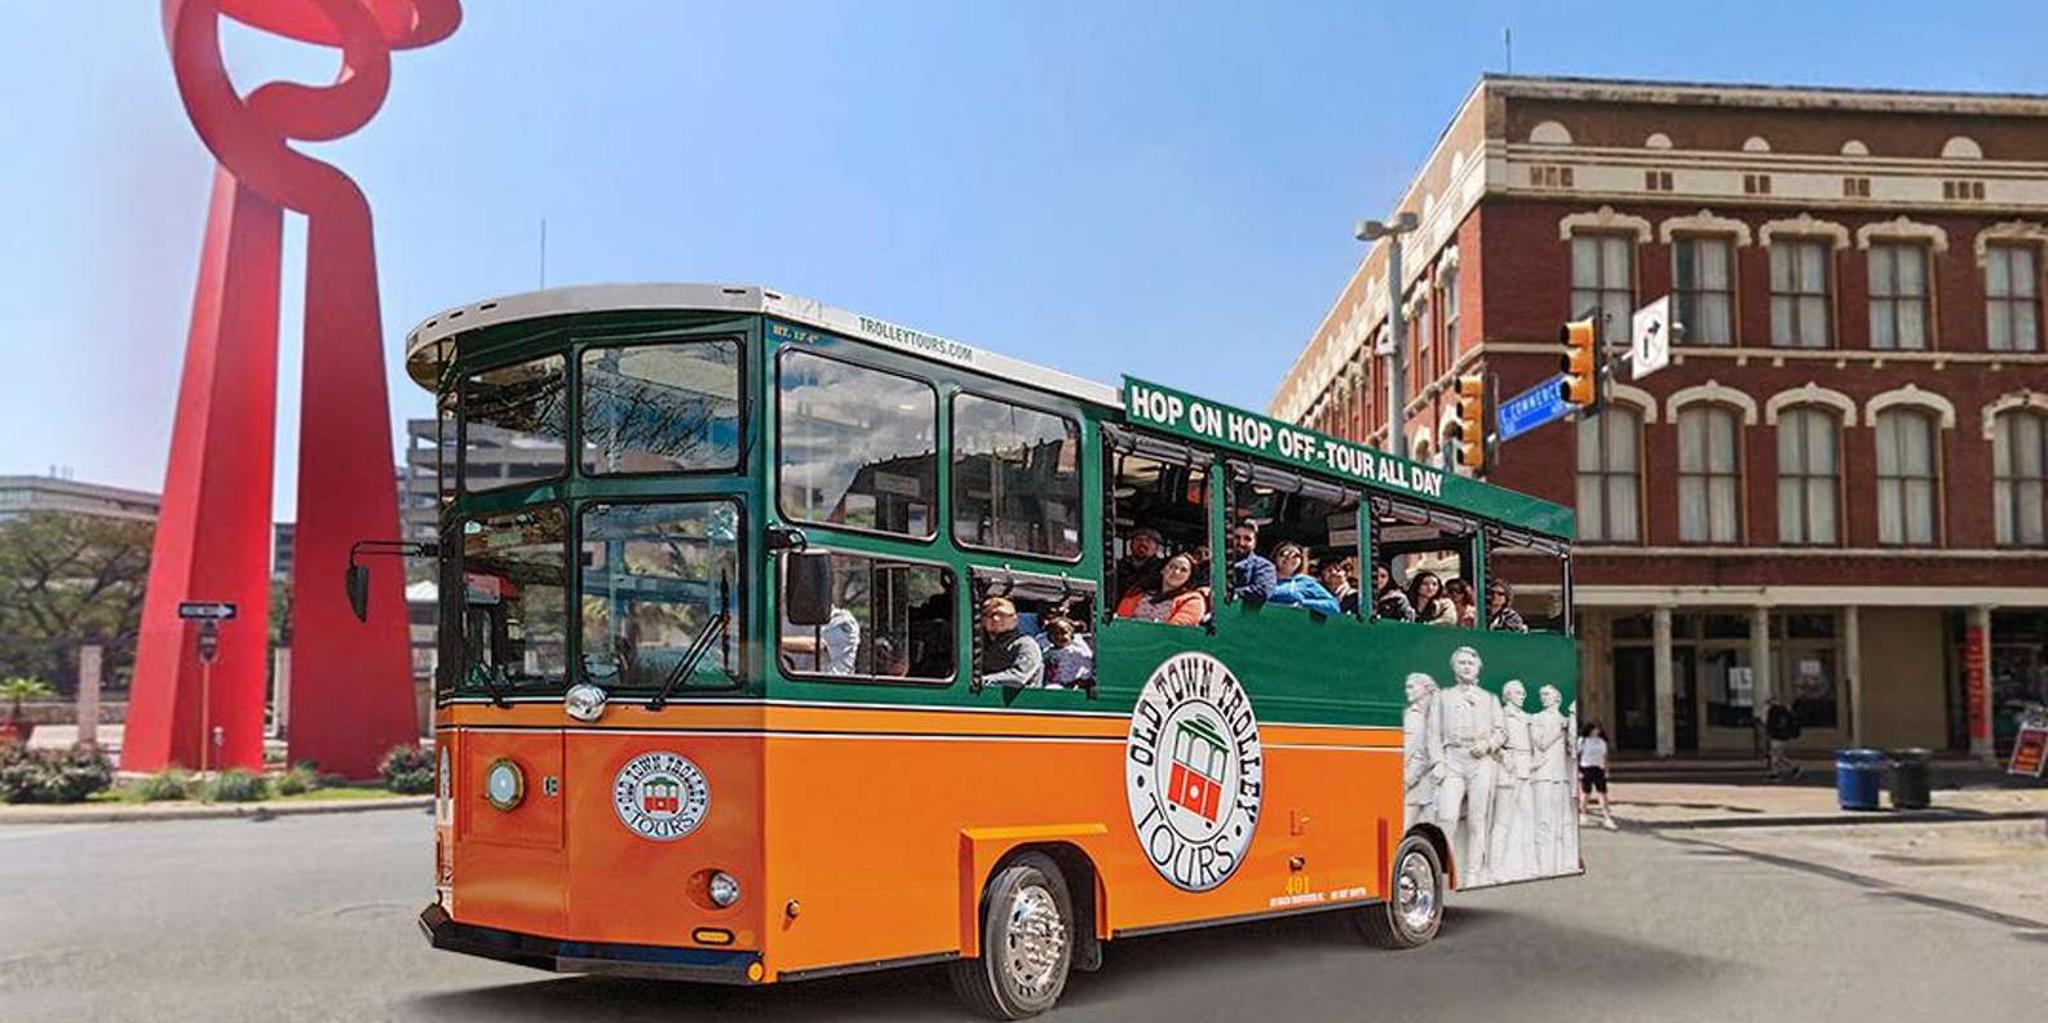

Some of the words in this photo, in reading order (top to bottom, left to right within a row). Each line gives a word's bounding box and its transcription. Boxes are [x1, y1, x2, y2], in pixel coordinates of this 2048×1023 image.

[858, 317, 973, 362] TROLLEYTOURS.COM
[1510, 381, 1562, 420] COMMERCE
[1131, 385, 1184, 426] HOP
[1189, 402, 1223, 438] ON
[1228, 412, 1273, 449] HOP
[1377, 457, 1410, 488] ALL
[1411, 466, 1443, 497] DAY
[1130, 702, 1162, 767] OLD
[1155, 657, 1214, 709] TOWN
[1215, 674, 1262, 825] TROLLEY
[625, 756, 660, 779] TOWN
[630, 808, 695, 836] TOURS
[1138, 792, 1235, 887] TOURS
[1285, 875, 1309, 895] 401
